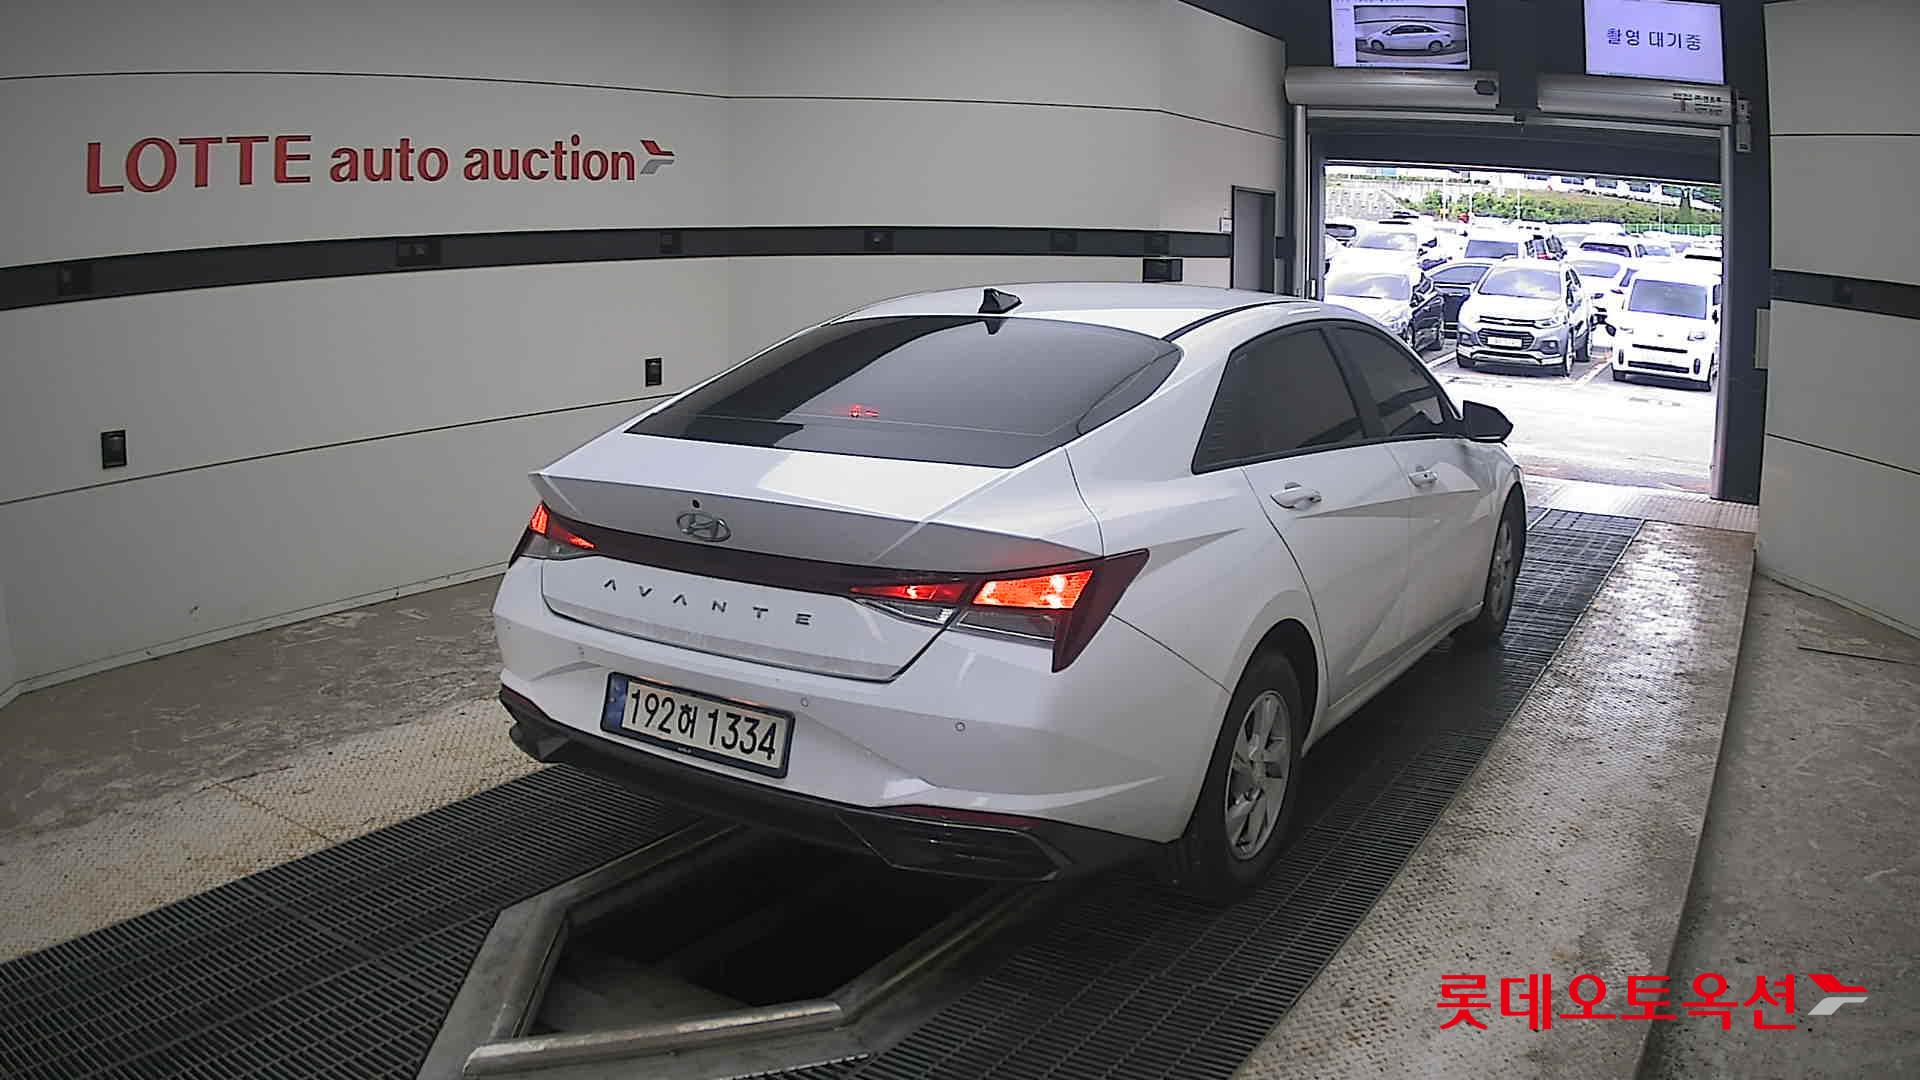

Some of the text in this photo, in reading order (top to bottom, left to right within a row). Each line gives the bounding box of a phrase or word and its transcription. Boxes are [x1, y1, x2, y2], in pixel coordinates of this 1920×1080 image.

[86, 134, 636, 194] LOTTE auto auction
[604, 579, 812, 625] AVANTE
[631, 689, 778, 760] 192허 1334
